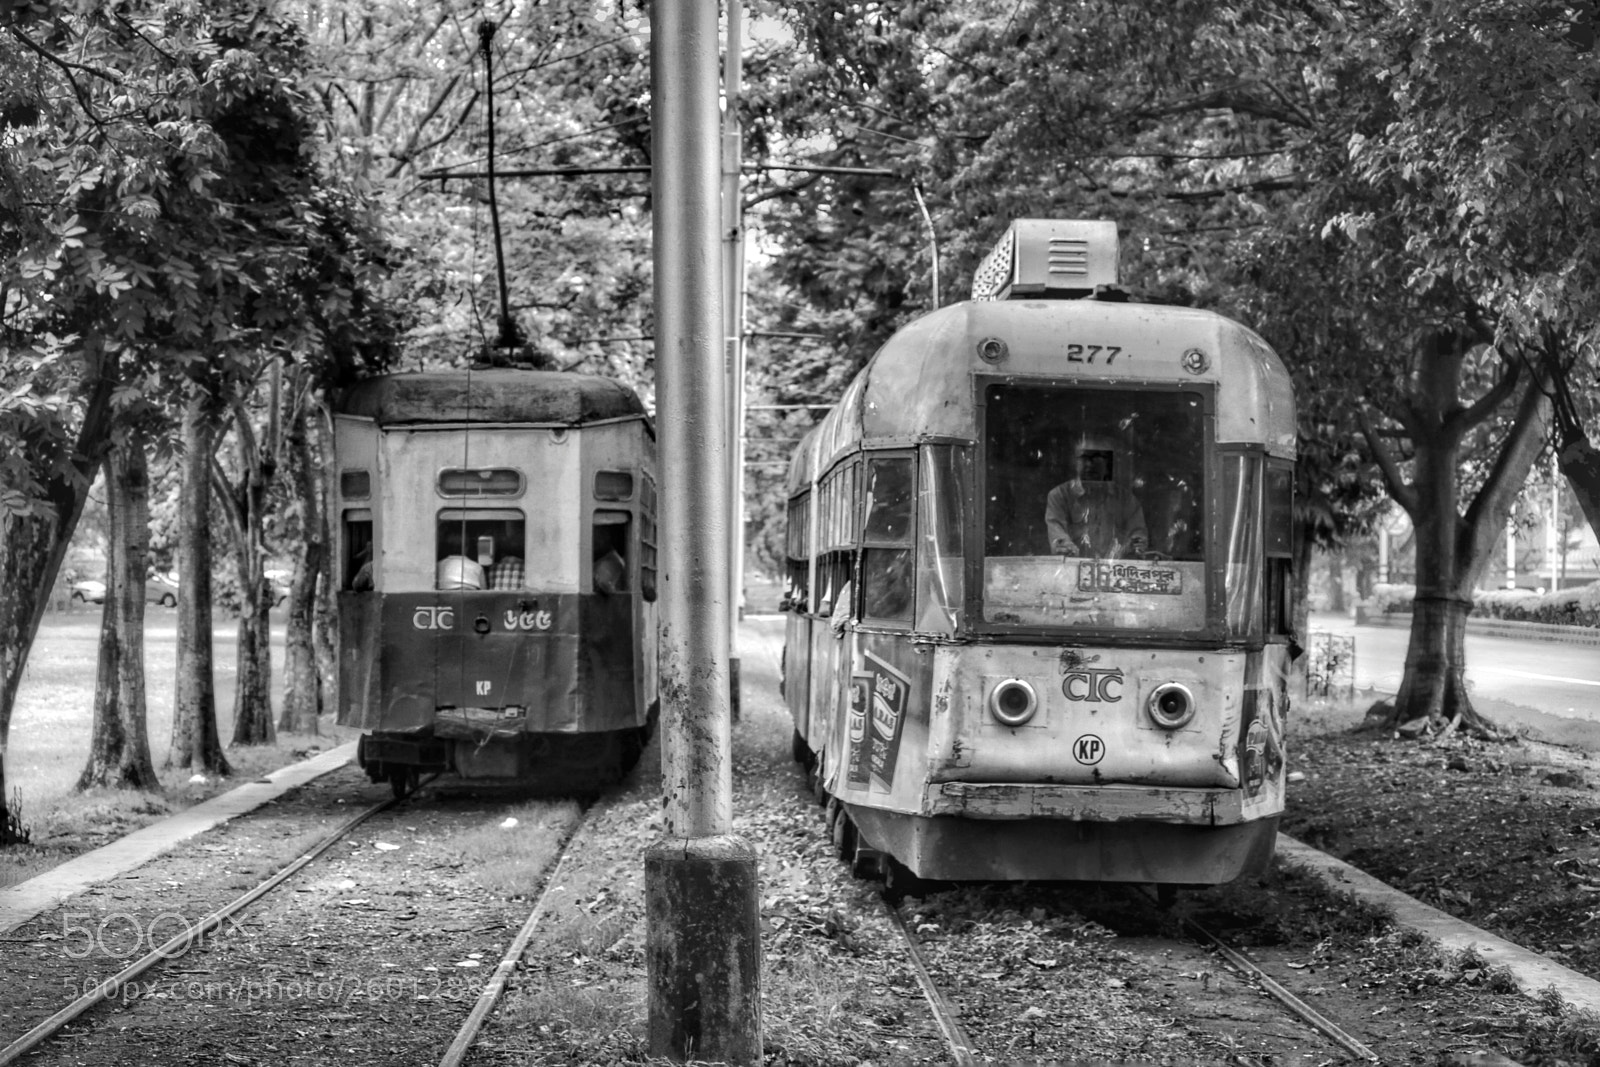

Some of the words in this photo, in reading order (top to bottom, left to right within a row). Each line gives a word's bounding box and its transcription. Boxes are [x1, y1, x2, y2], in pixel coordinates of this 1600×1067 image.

[1067, 343, 1122, 365] 277
[412, 606, 454, 630] CTC
[475, 680, 492, 696] KP
[1062, 667, 1125, 703] CTC
[1078, 740, 1100, 760] KP
